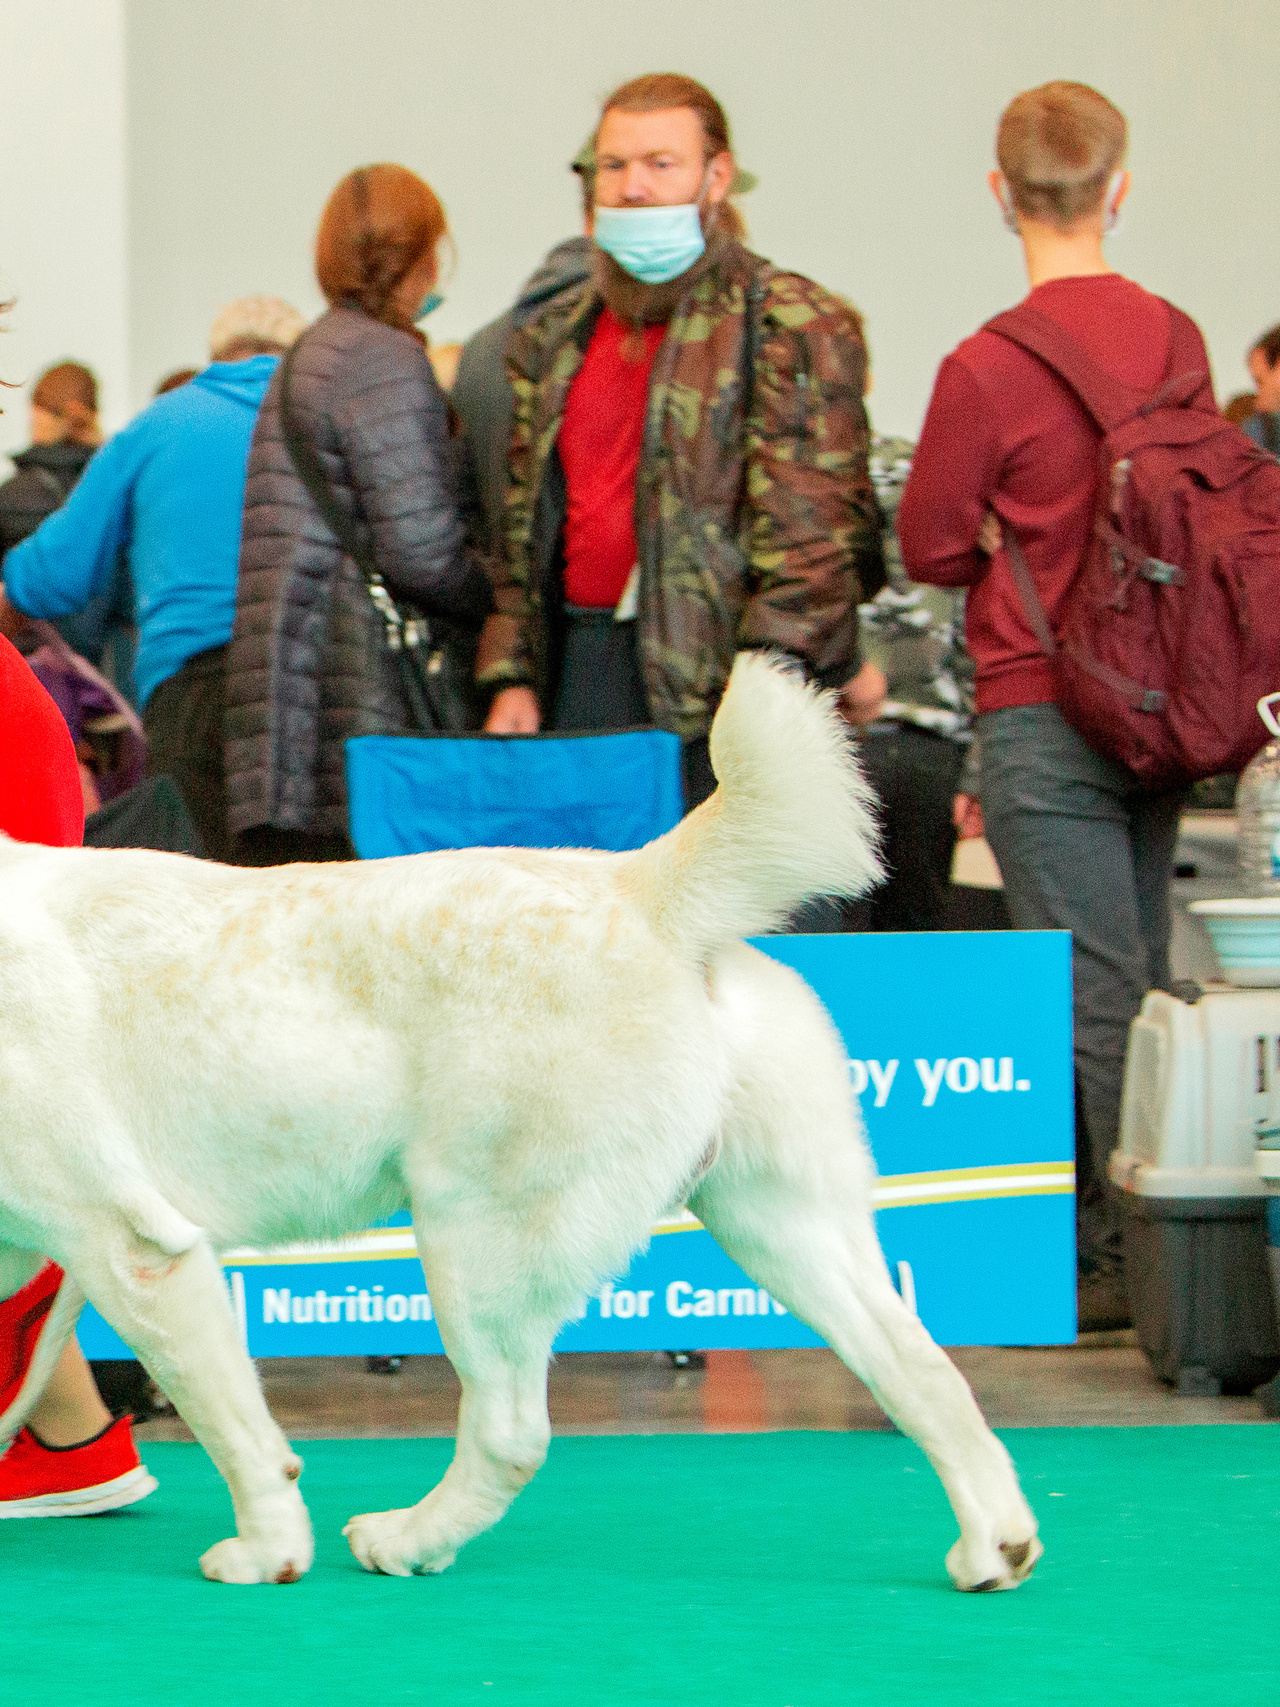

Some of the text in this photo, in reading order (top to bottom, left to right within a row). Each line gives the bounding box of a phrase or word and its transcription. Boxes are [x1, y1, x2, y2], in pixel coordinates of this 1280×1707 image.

[913, 1056, 1032, 1108] you.
[262, 1286, 432, 1324] Nutrition
[600, 1282, 655, 1319] for
